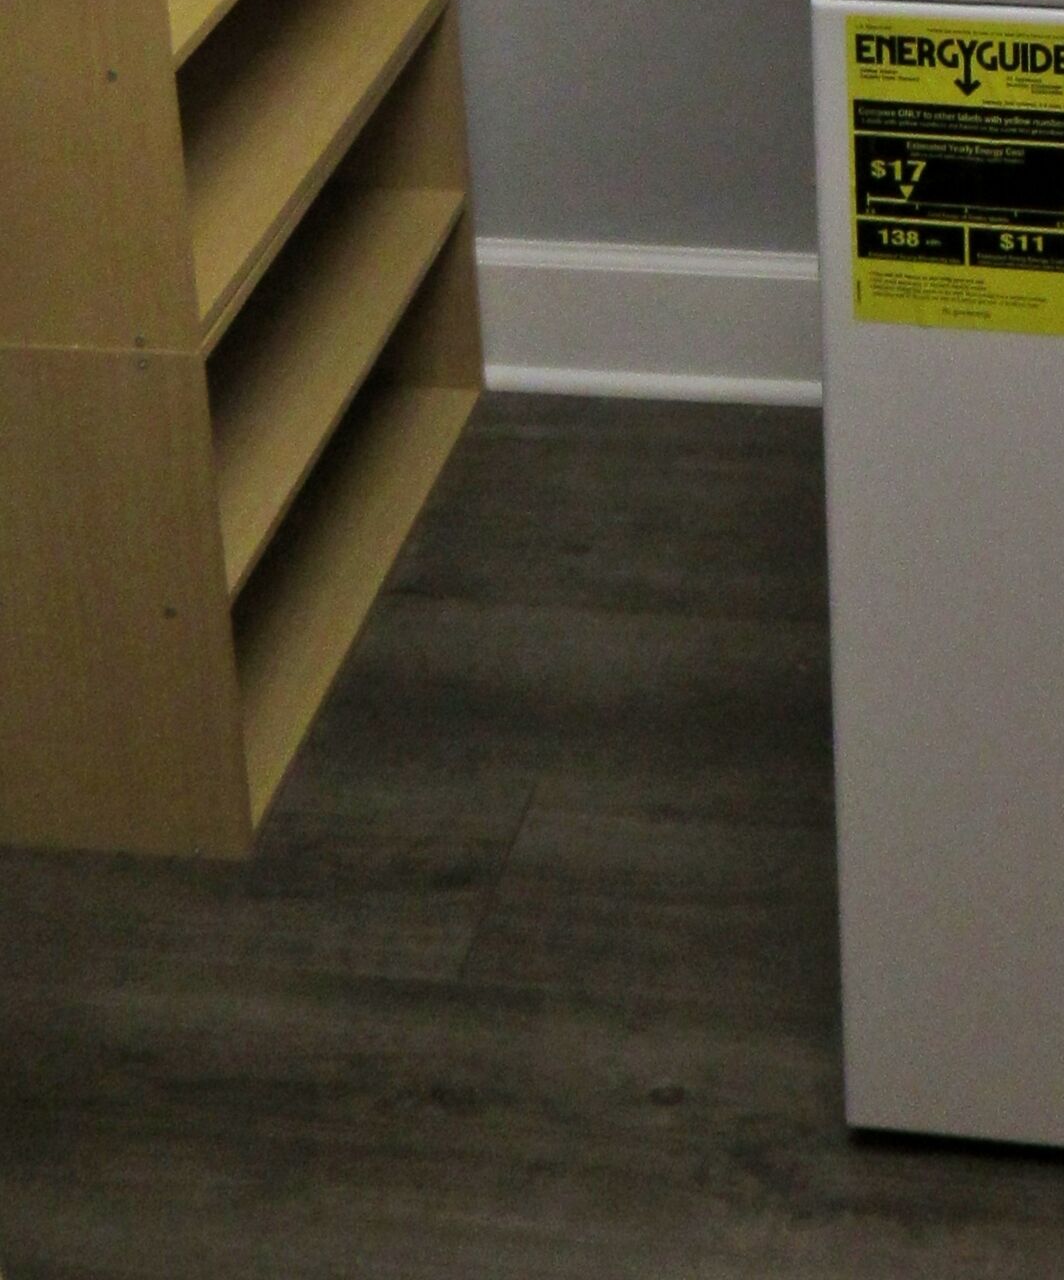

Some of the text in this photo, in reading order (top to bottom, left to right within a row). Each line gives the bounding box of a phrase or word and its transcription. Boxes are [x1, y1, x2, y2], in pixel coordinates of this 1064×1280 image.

[897, 108, 921, 120] ONLY
[922, 111, 932, 120] to
[933, 112, 955, 121] other
[957, 112, 982, 123] labels
[984, 115, 1002, 124] with
[1003, 116, 1031, 128] yellow
[870, 159, 927, 183] $17
[877, 228, 920, 248] 138
[999, 232, 1044, 252] $11
